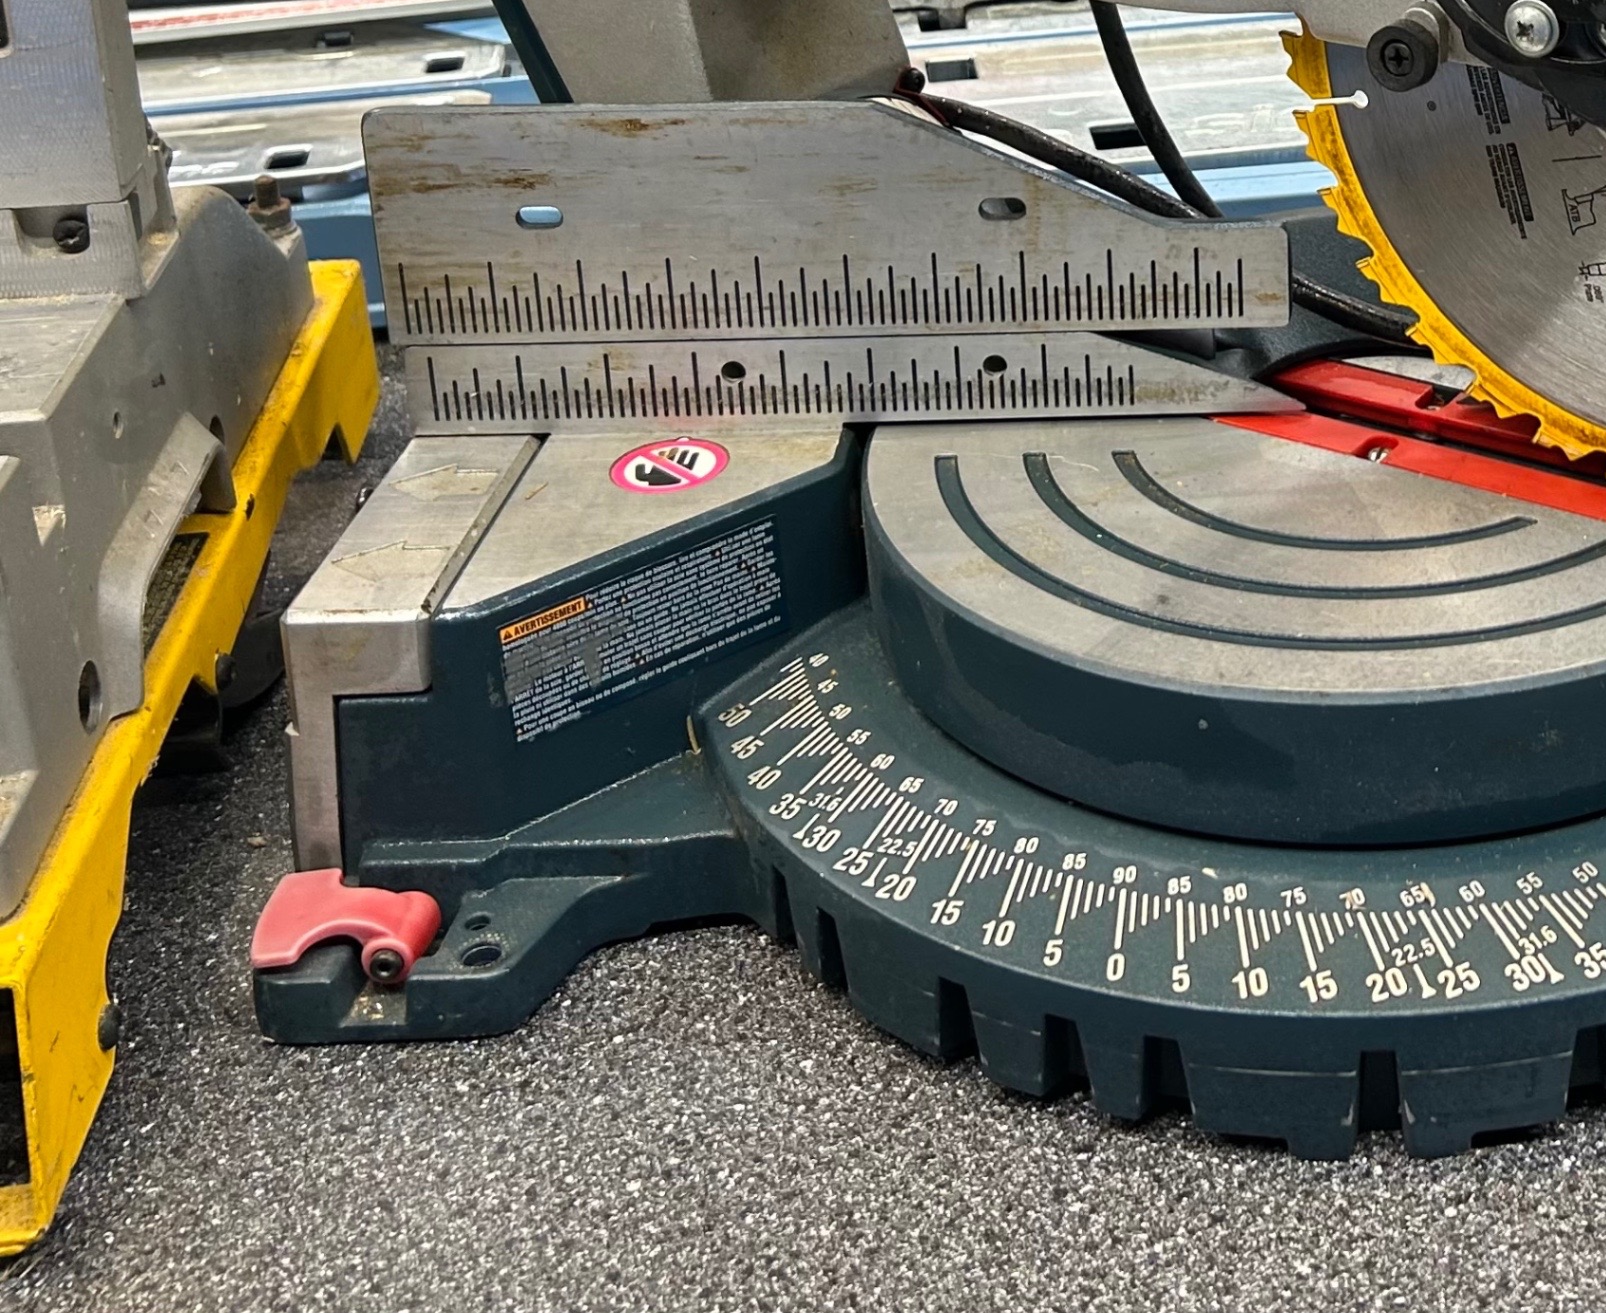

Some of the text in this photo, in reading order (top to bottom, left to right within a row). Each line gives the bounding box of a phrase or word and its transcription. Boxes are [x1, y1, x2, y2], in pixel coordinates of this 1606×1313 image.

[1568, 204, 1580, 222] ATB
[513, 599, 582, 636] AVERTISSEMENT
[808, 652, 830, 668] 40
[818, 678, 838, 695] 45
[718, 703, 754, 728] 50
[829, 704, 852, 720] 50
[729, 736, 765, 762] 45
[846, 728, 872, 746] 55
[870, 753, 895, 770] 60
[747, 765, 782, 791] 40
[898, 776, 924, 794] 65
[769, 793, 806, 821] 35
[808, 791, 843, 812] 31.6
[932, 798, 958, 816] 70
[972, 818, 997, 836] 75
[802, 828, 840, 853] 30
[878, 838, 916, 857] 22.5
[1013, 836, 1040, 854] 80
[832, 846, 870, 874] 25
[1062, 852, 1087, 871] 85
[1112, 865, 1138, 884] 90
[1168, 876, 1192, 895] 85
[1516, 872, 1544, 895] 55
[1571, 862, 1599, 885] 50
[874, 874, 917, 902] 20
[1222, 883, 1248, 902] 80
[1280, 887, 1306, 907] 75
[1340, 888, 1366, 910] 70
[1458, 880, 1486, 904] 60
[930, 900, 964, 926] 15
[981, 920, 1016, 946] 10
[1517, 926, 1558, 956] 31.6
[1043, 940, 1064, 966] 5
[1391, 939, 1438, 967] 22.5
[1106, 953, 1125, 982] 0
[1172, 964, 1191, 992] 5
[1504, 955, 1544, 992] 30
[1230, 972, 1269, 999] 10
[1299, 970, 1339, 1004] 15
[1365, 970, 1409, 1003] 20
[1436, 963, 1481, 999] 25
